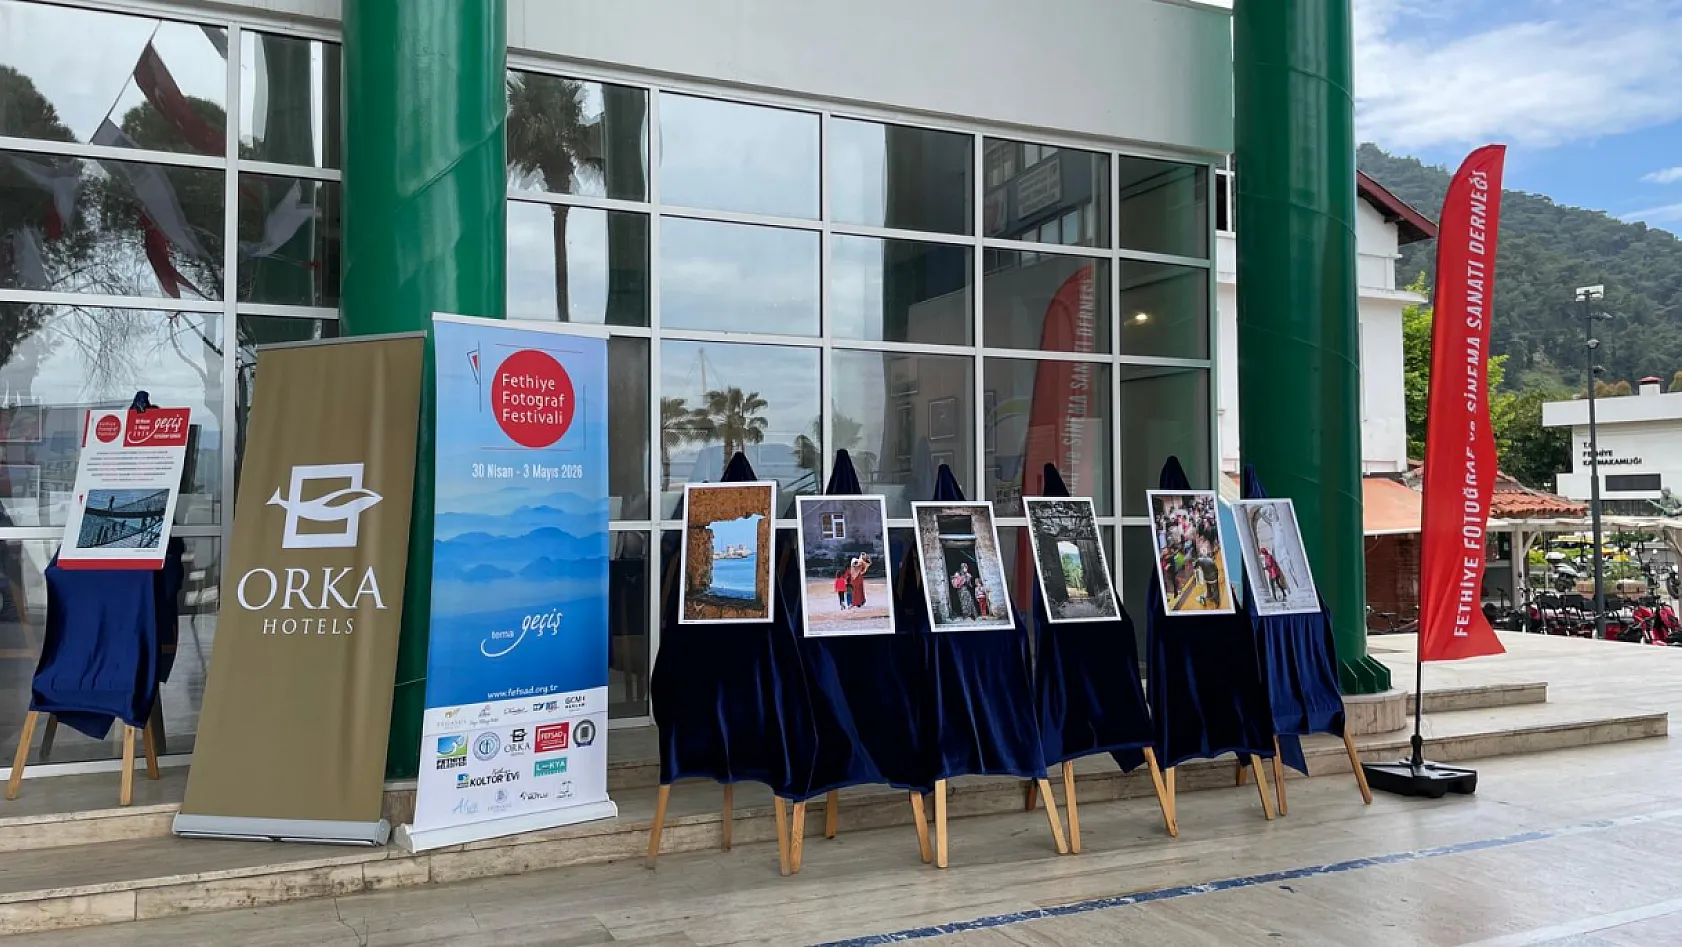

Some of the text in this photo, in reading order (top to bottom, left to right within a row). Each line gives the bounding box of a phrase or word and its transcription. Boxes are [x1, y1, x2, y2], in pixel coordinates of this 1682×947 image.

[1466, 260, 1485, 330] SANATI
[502, 373, 556, 392] Fethiye
[1464, 337, 1481, 413] SİNEMA
[502, 408, 563, 425] Festivali
[1583, 448, 1614, 457] FEHİYE
[1583, 457, 1642, 466] KAMAKAMLIĞI
[472, 463, 485, 478] 30
[487, 463, 514, 478] Nisan
[523, 464, 530, 478] 3
[532, 464, 559, 481] Mayıs
[561, 464, 583, 479] 2026
[1462, 446, 1482, 549] FOTOĞRAF
[237, 565, 388, 611] ORKA
[1454, 556, 1479, 637] FETHİYE
[262, 618, 354, 635] HOTELS
[491, 608, 563, 640] tema geçiş
